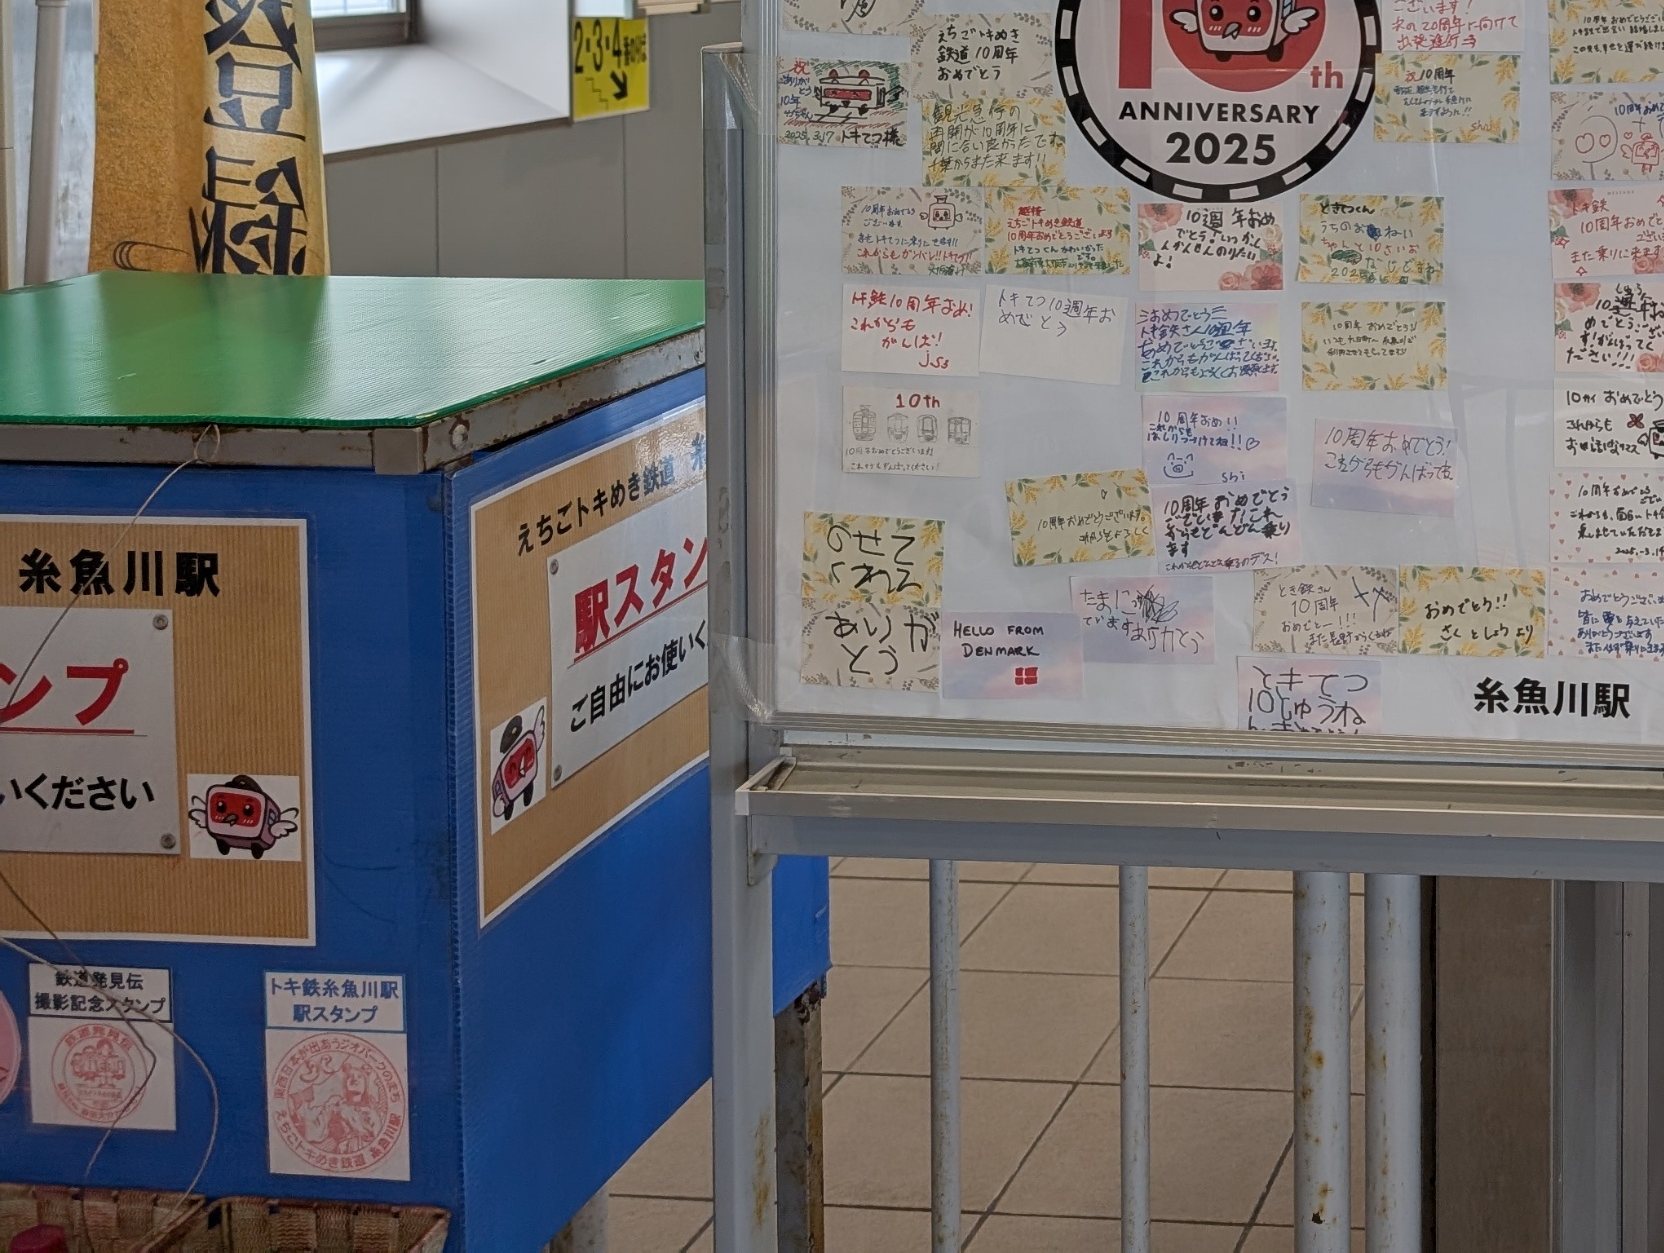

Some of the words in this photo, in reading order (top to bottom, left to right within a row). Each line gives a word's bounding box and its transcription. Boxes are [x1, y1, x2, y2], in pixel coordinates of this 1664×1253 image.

[1119, 101, 1320, 124] ANNIVERSARY
[1166, 132, 1276, 165] 2025
[895, 393, 940, 408] 10th
[517, 455, 676, 557] えちごトキめき鉄道
[18, 547, 221, 598] 糸魚川駅
[953, 621, 994, 637] HELLO
[1008, 623, 1044, 636] FROM
[963, 643, 1040, 658] DENMARK
[1474, 677, 1631, 718] 糸魚川駅
[55, 970, 144, 991] 鉄道発見伝
[270, 978, 399, 1000] トキ鉄糸魚川駅
[34, 992, 166, 1014] 撮影記念スタンプ
[293, 1005, 378, 1024] 駅スタンプ
